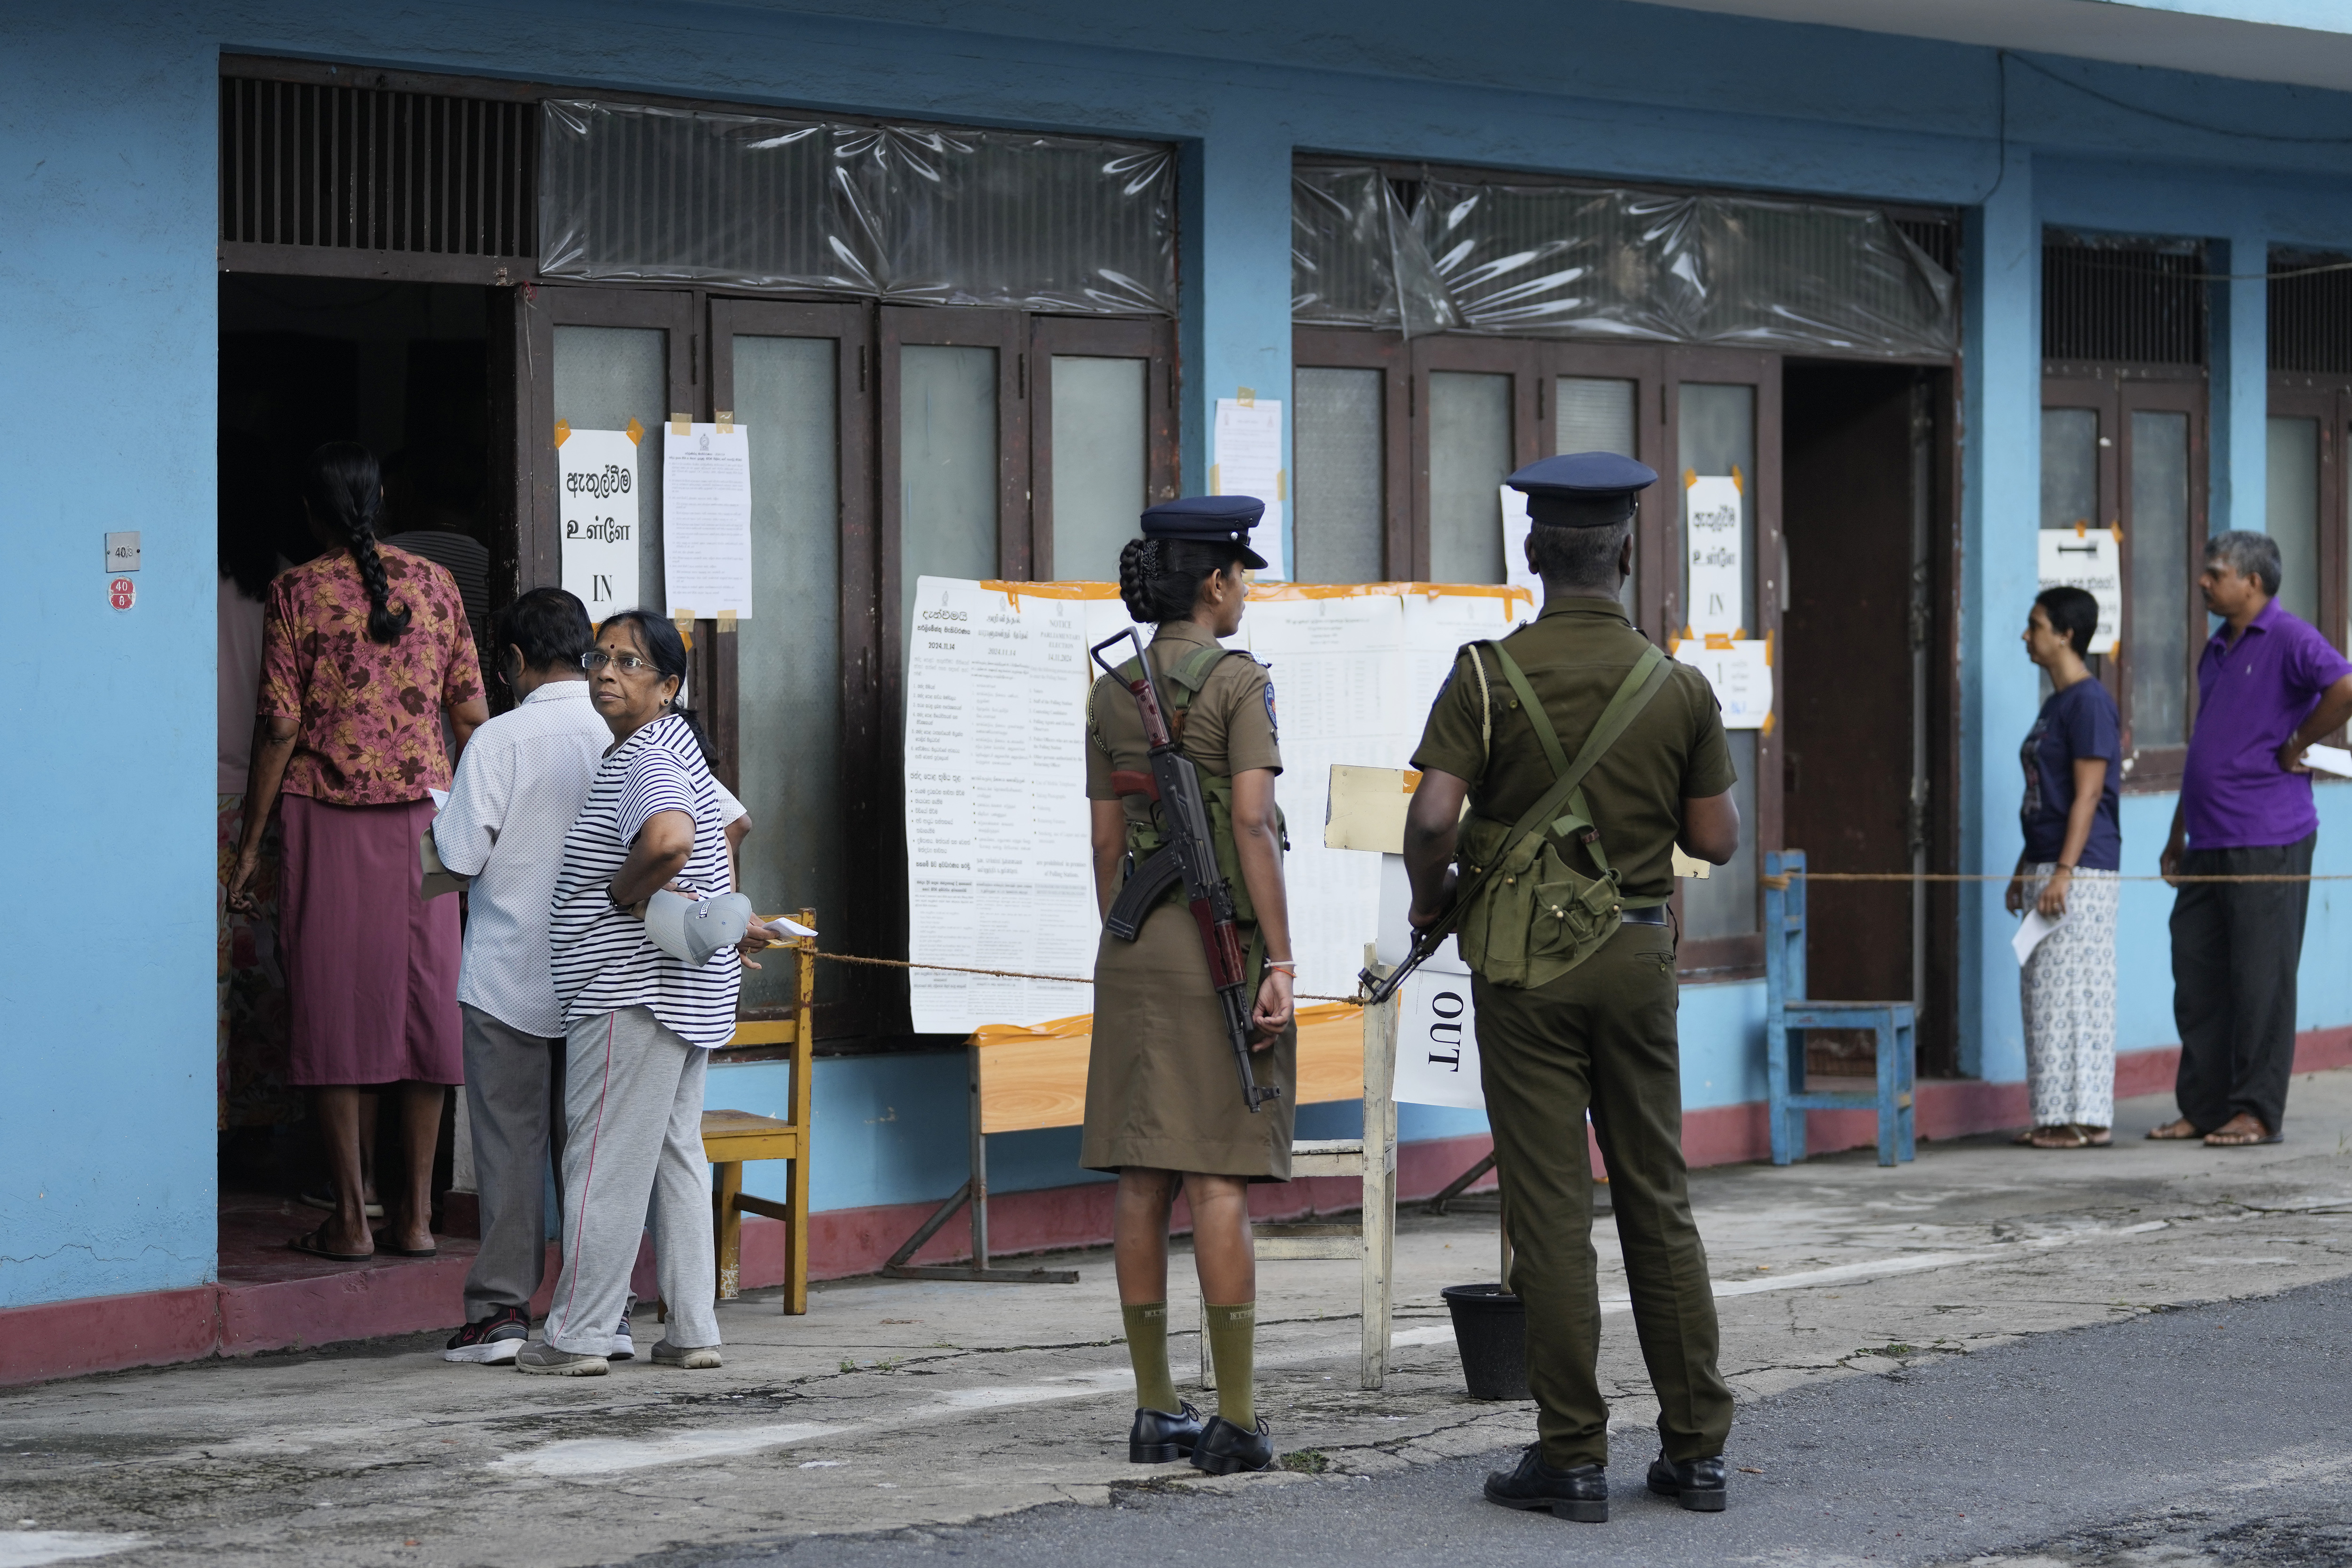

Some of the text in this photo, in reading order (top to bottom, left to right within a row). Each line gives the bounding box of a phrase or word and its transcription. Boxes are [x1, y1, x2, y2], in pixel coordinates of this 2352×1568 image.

[566, 464, 631, 499] ඇතුල්වීම
[567, 515, 631, 543] உள்ளே
[116, 581, 127, 591] 40
[592, 574, 612, 602] IN
[119, 596, 124, 605] 8
[923, 609, 968, 621] දැන්වීමයි
[1049, 620, 1072, 629] NOTICE
[1041, 632, 1081, 640] PARLIAMENTARY
[1048, 653, 1072, 662] 14.11.2024
[1428, 992, 1464, 1072] OUT
